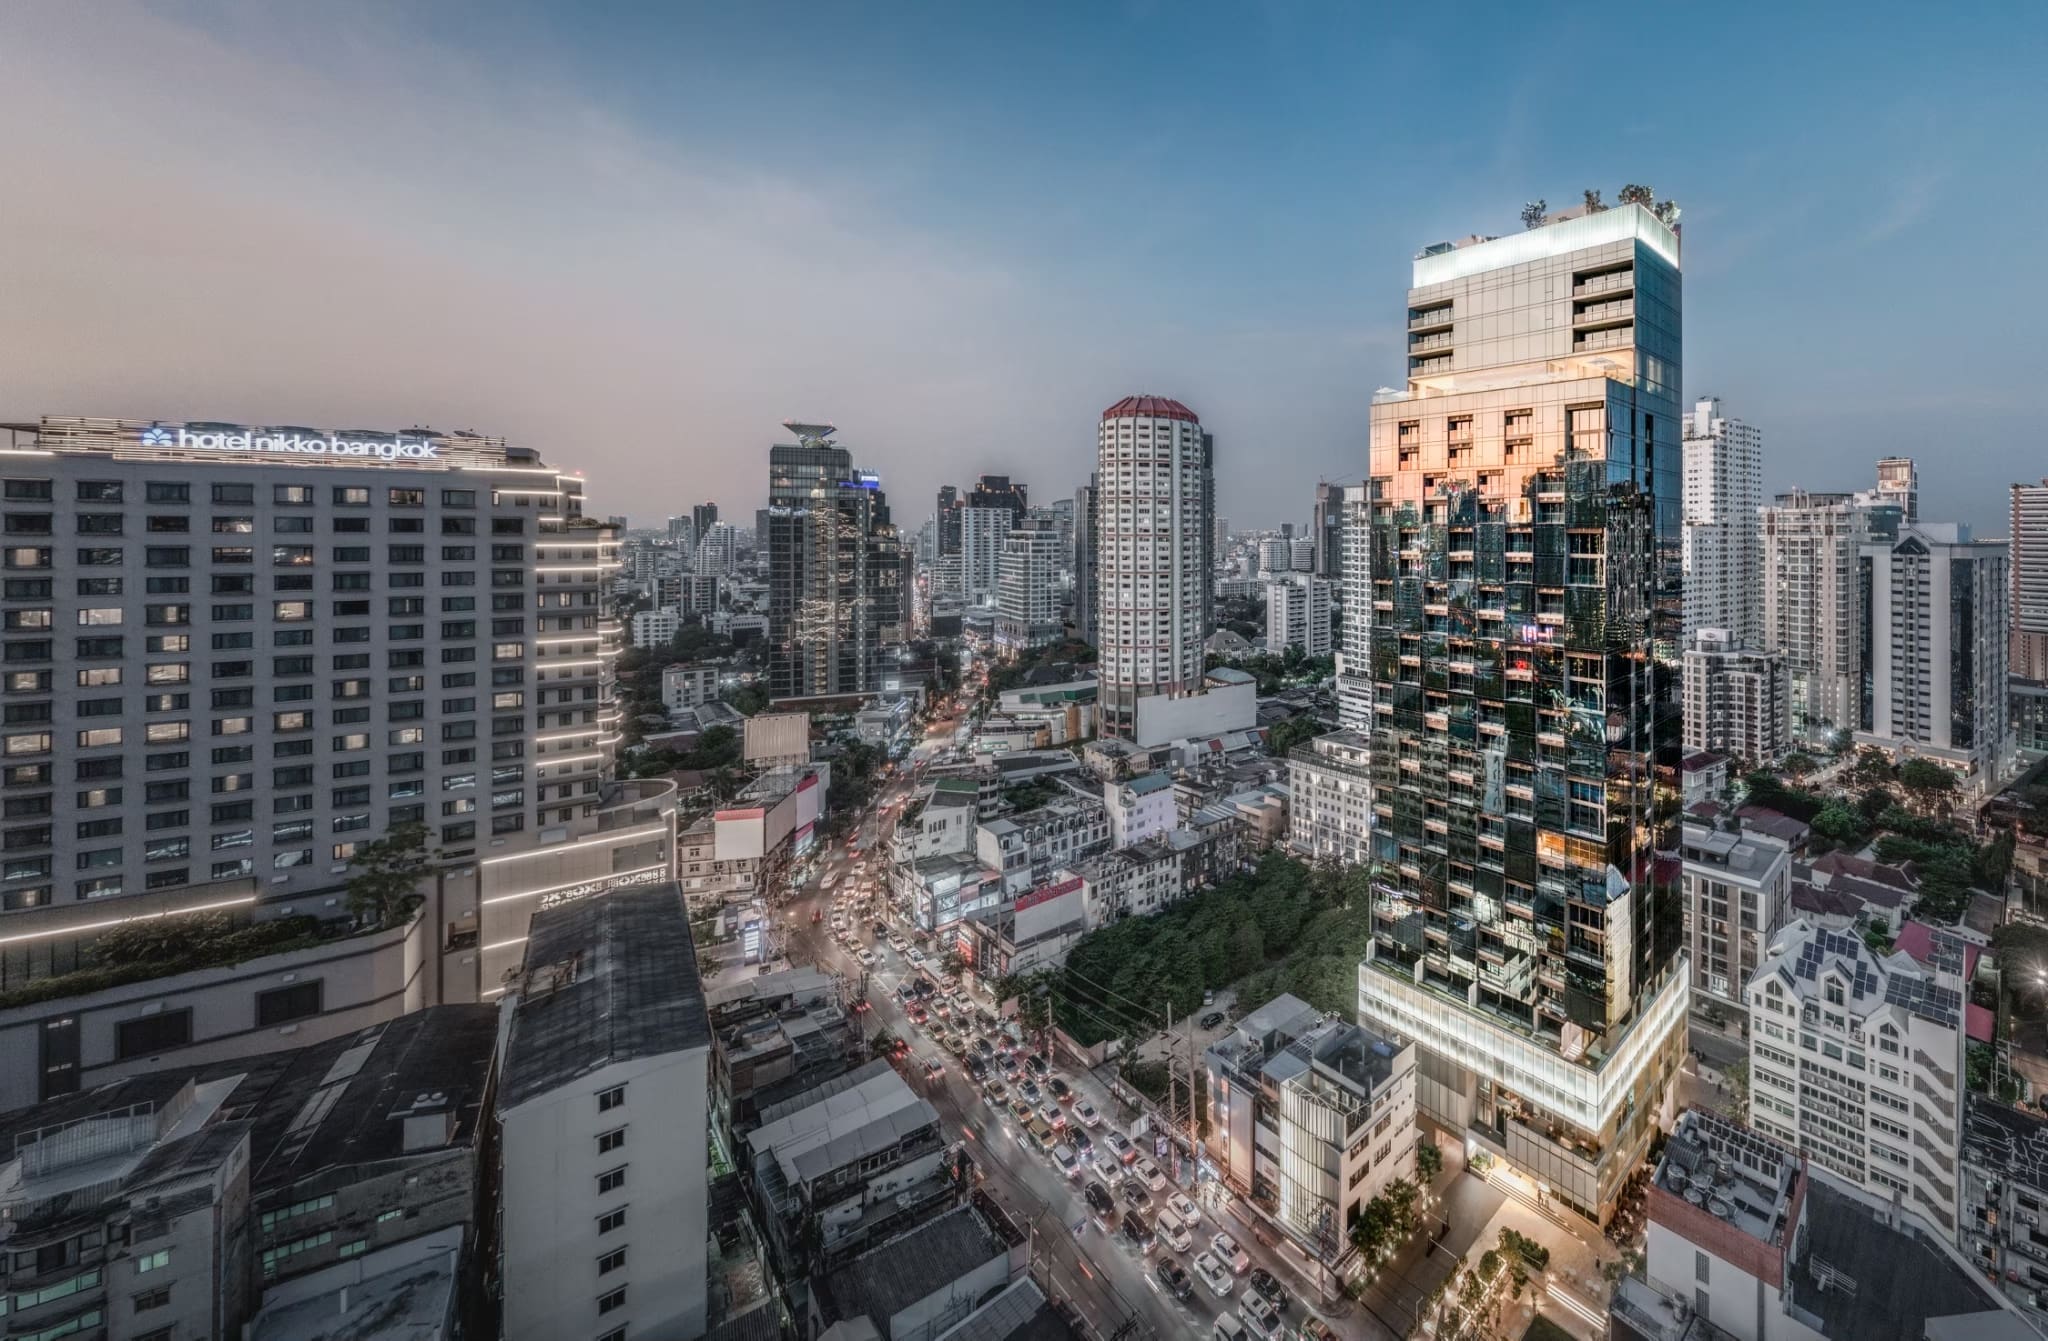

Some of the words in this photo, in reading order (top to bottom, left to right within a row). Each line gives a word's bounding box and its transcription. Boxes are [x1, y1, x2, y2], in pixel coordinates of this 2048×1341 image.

[180, 429, 250, 450] hotel
[257, 434, 326, 453] nikko
[332, 437, 437, 460] bangkok
